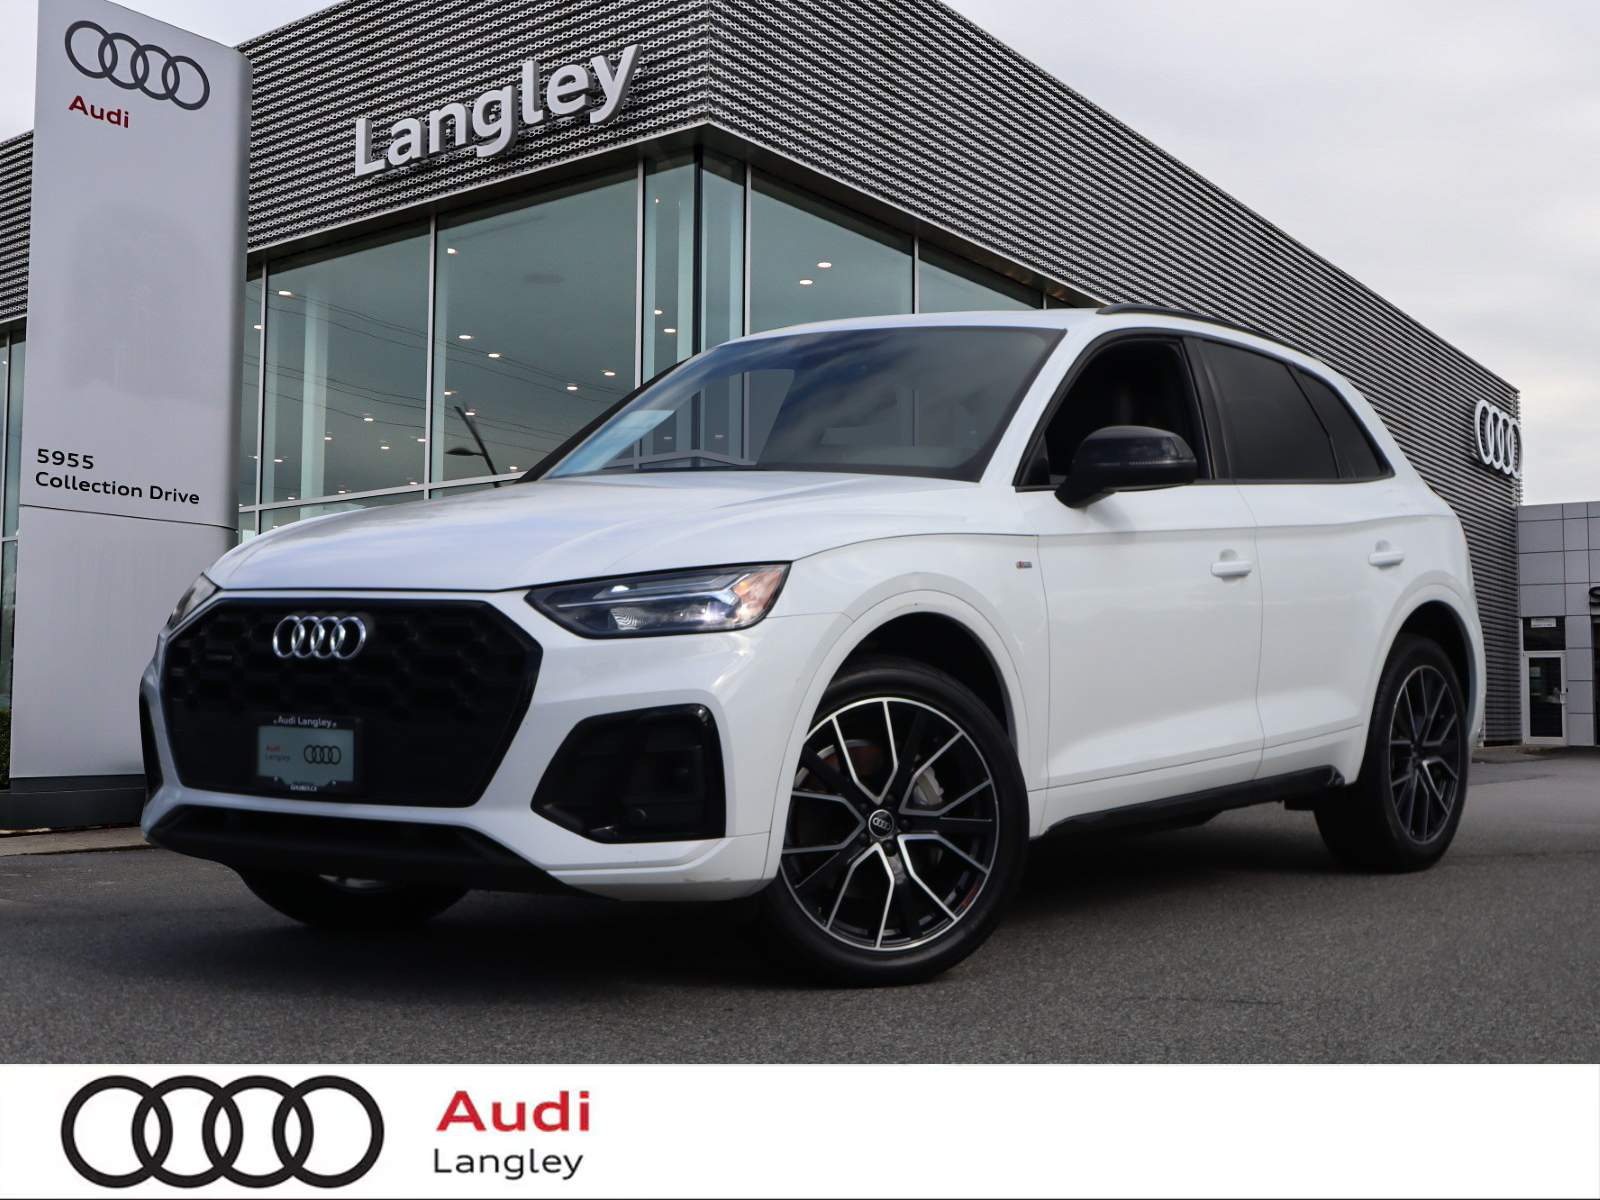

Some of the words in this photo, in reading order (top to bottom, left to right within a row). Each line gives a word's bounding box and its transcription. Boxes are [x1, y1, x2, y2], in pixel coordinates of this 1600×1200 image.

[68, 95, 129, 129] Audi
[355, 44, 643, 177] Langley
[37, 448, 94, 470] 5955
[35, 471, 142, 498] Collection
[149, 485, 200, 505] Drive
[277, 716, 296, 725] Audi
[297, 717, 332, 728] Langley
